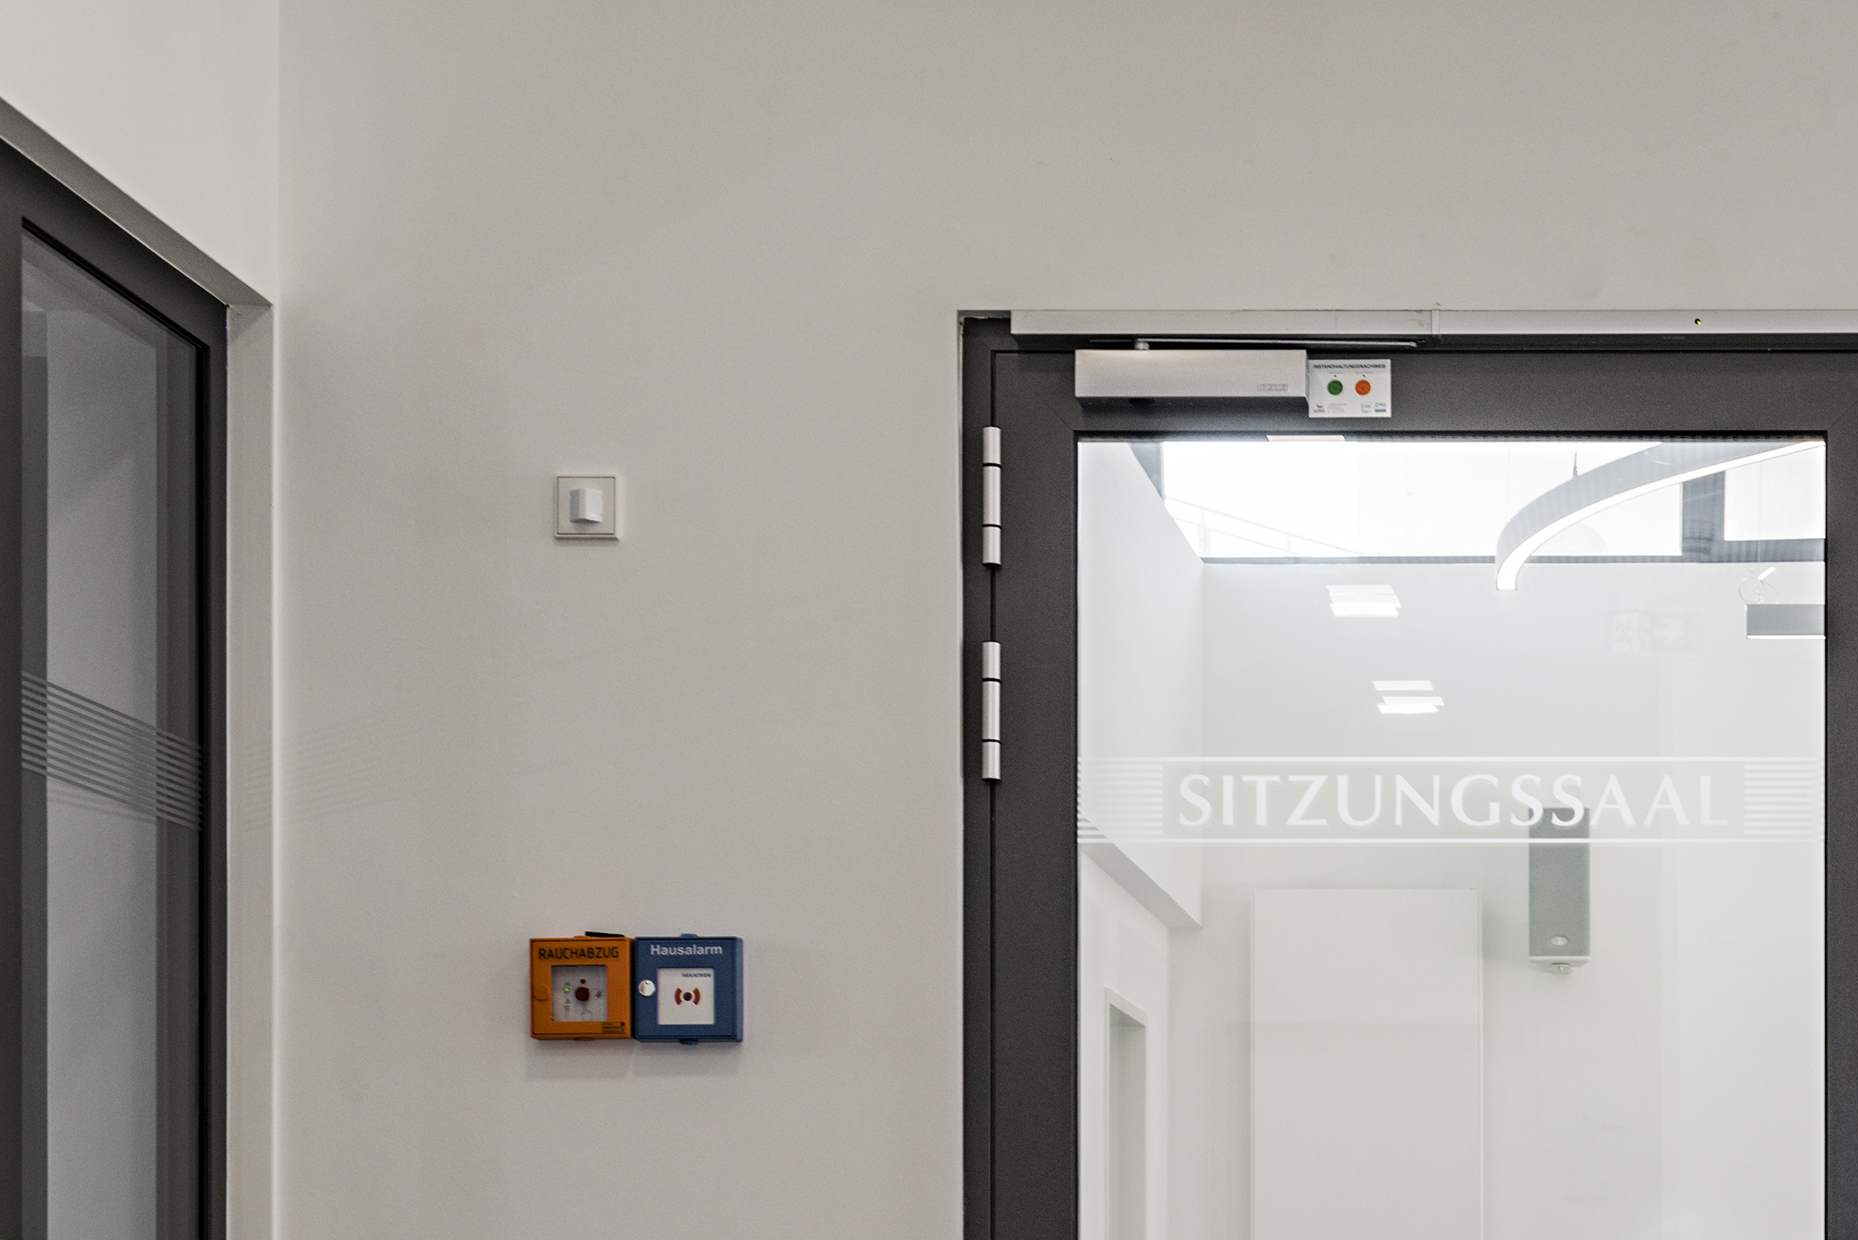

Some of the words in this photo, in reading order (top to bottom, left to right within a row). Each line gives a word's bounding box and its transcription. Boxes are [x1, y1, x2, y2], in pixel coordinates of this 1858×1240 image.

[1178, 773, 1729, 828] SITZUNGSSAAL
[538, 946, 619, 960] RAUCHABZUG
[650, 944, 723, 956] Hausalarm
